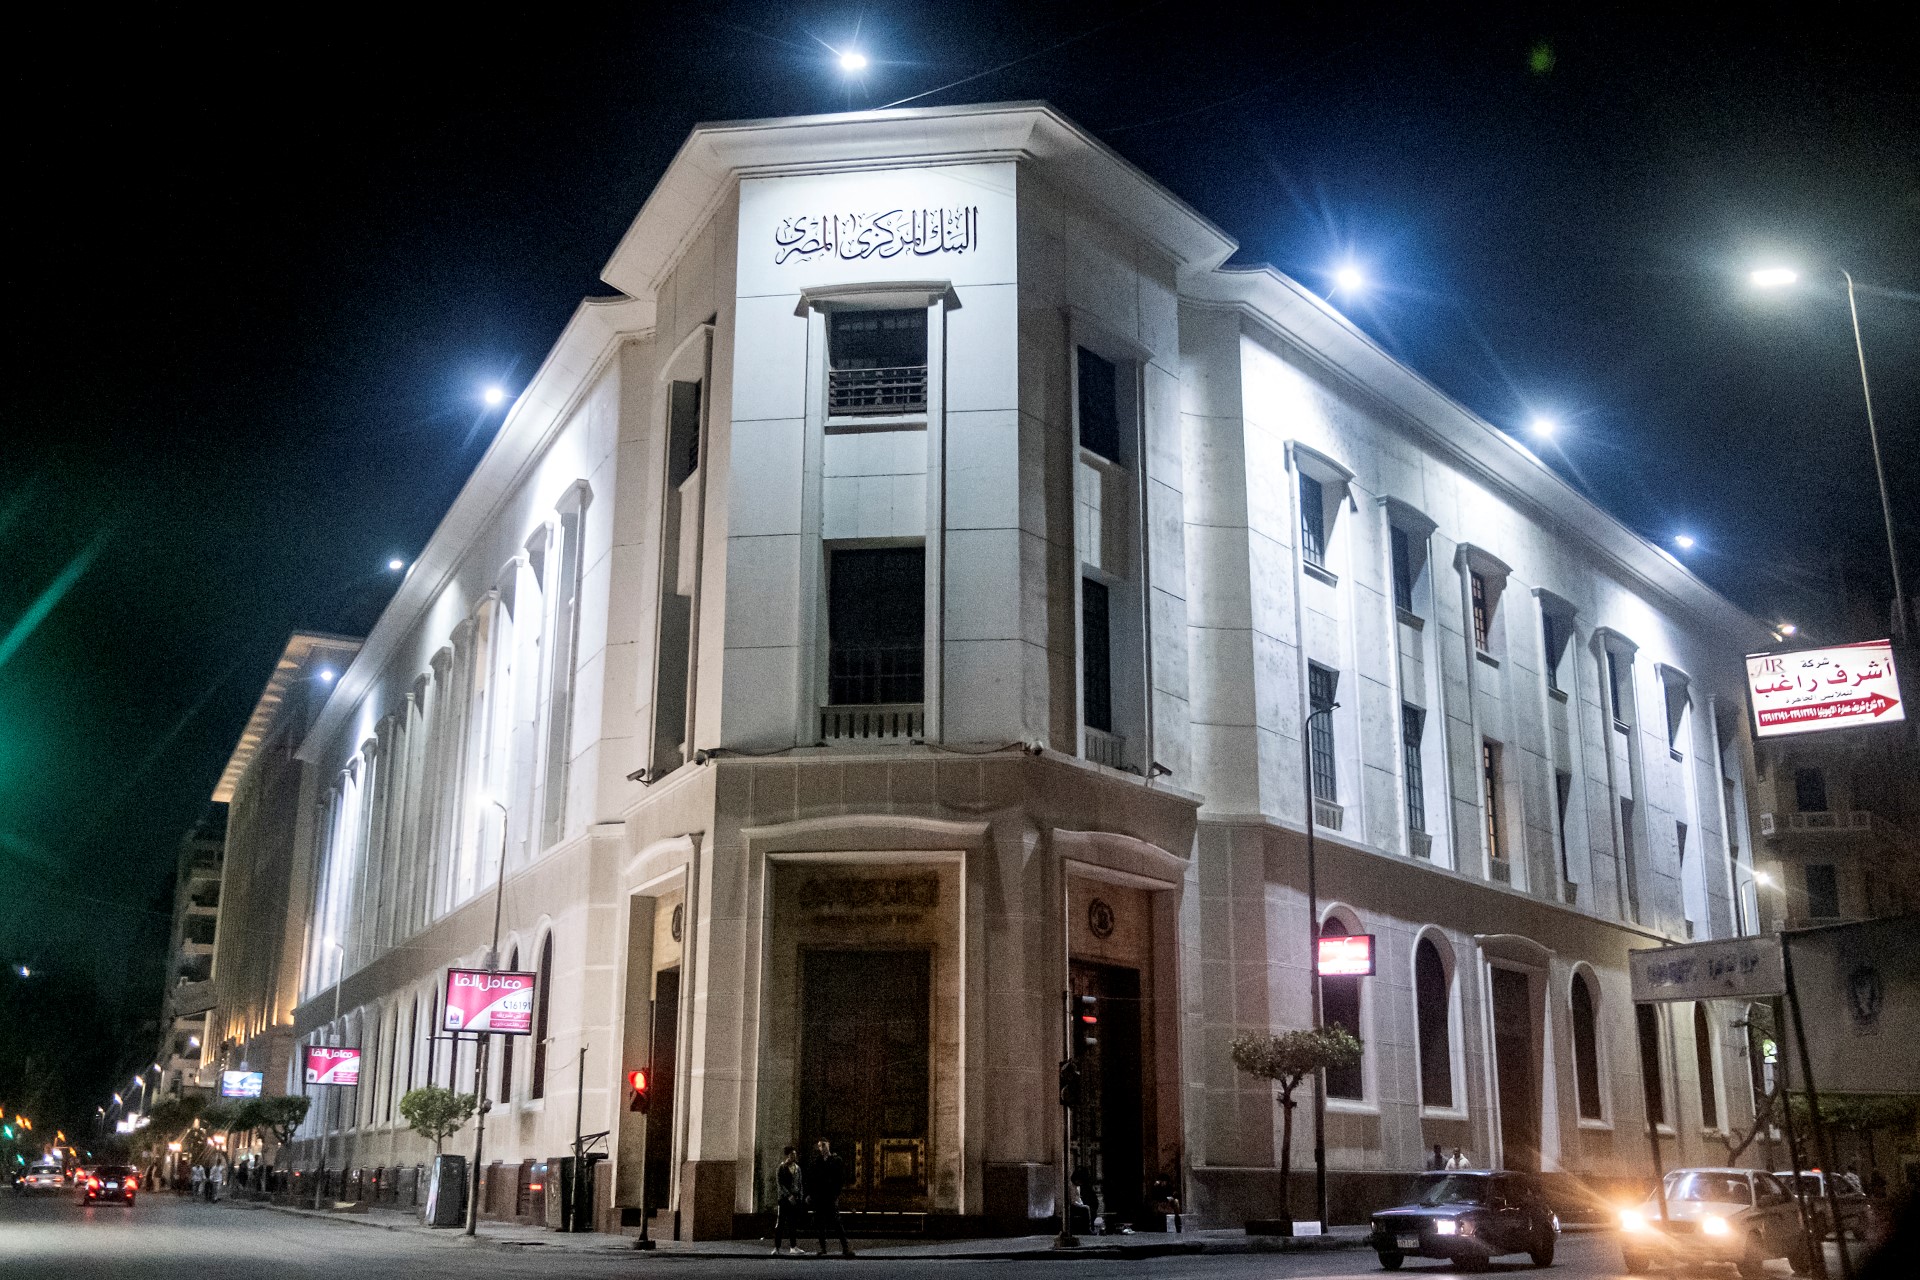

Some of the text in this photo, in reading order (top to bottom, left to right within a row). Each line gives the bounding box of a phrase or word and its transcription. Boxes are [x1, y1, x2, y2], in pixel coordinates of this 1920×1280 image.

[912, 204, 979, 256] البنك
[1754, 656, 1893, 698] أشرف راغب
[454, 973, 522, 992] معامل الفا
[509, 1001, 531, 1010] 16191
[326, 1049, 353, 1060] معامل
